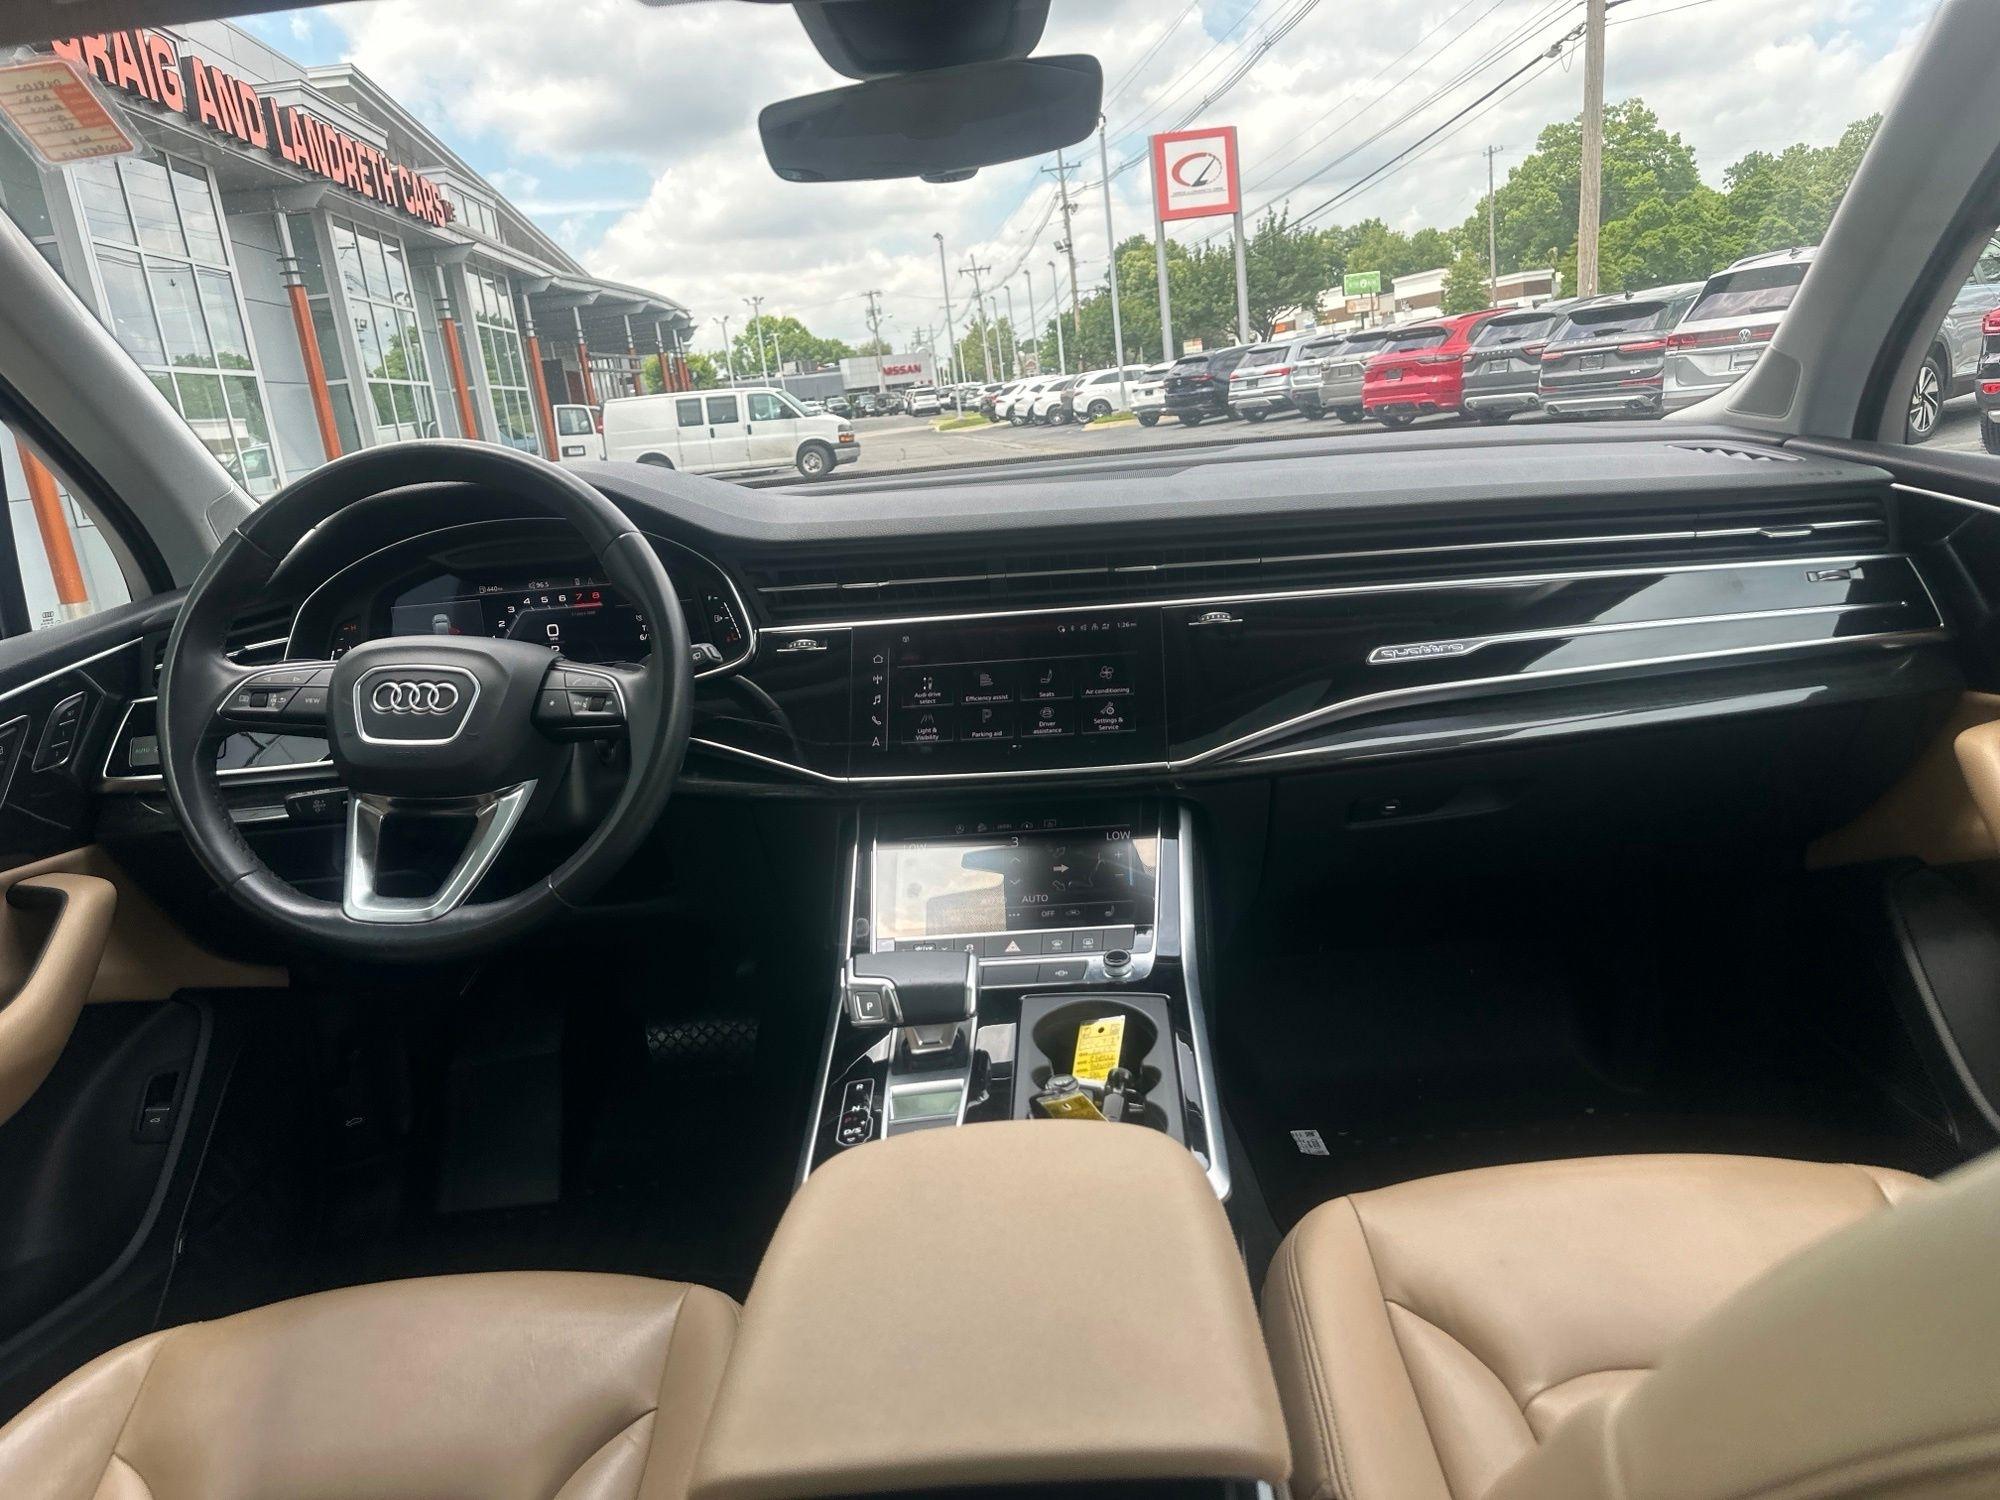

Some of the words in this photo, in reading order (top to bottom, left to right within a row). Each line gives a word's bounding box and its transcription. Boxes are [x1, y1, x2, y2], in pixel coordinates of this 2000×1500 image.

[190, 54, 268, 149] AND
[269, 96, 399, 208] LANDRETH
[398, 164, 447, 229] CARS
[540, 595, 549, 603] 5
[558, 594, 567, 602] 6
[575, 592, 583, 600] 7
[523, 597, 531, 605] 4
[507, 605, 516, 613] 3
[498, 620, 506, 628] 2
[1380, 643, 1464, 658] quattro
[1095, 686, 1130, 695] conditioning
[965, 694, 992, 703] Efficiency
[1038, 720, 1056, 728] Driver
[1093, 716, 1118, 725] Settings
[917, 727, 932, 735] Light
[1033, 727, 1063, 735] assistance
[1098, 723, 1120, 731] Service
[915, 733, 939, 742] Visibility
[971, 730, 993, 739] Parking
[994, 729, 1003, 737] aid
[1105, 830, 1132, 841] LOW
[1011, 836, 1019, 847] 3
[1021, 894, 1049, 904] AUTO
[866, 1001, 873, 1011] P
[843, 1127, 862, 1136] D/S
